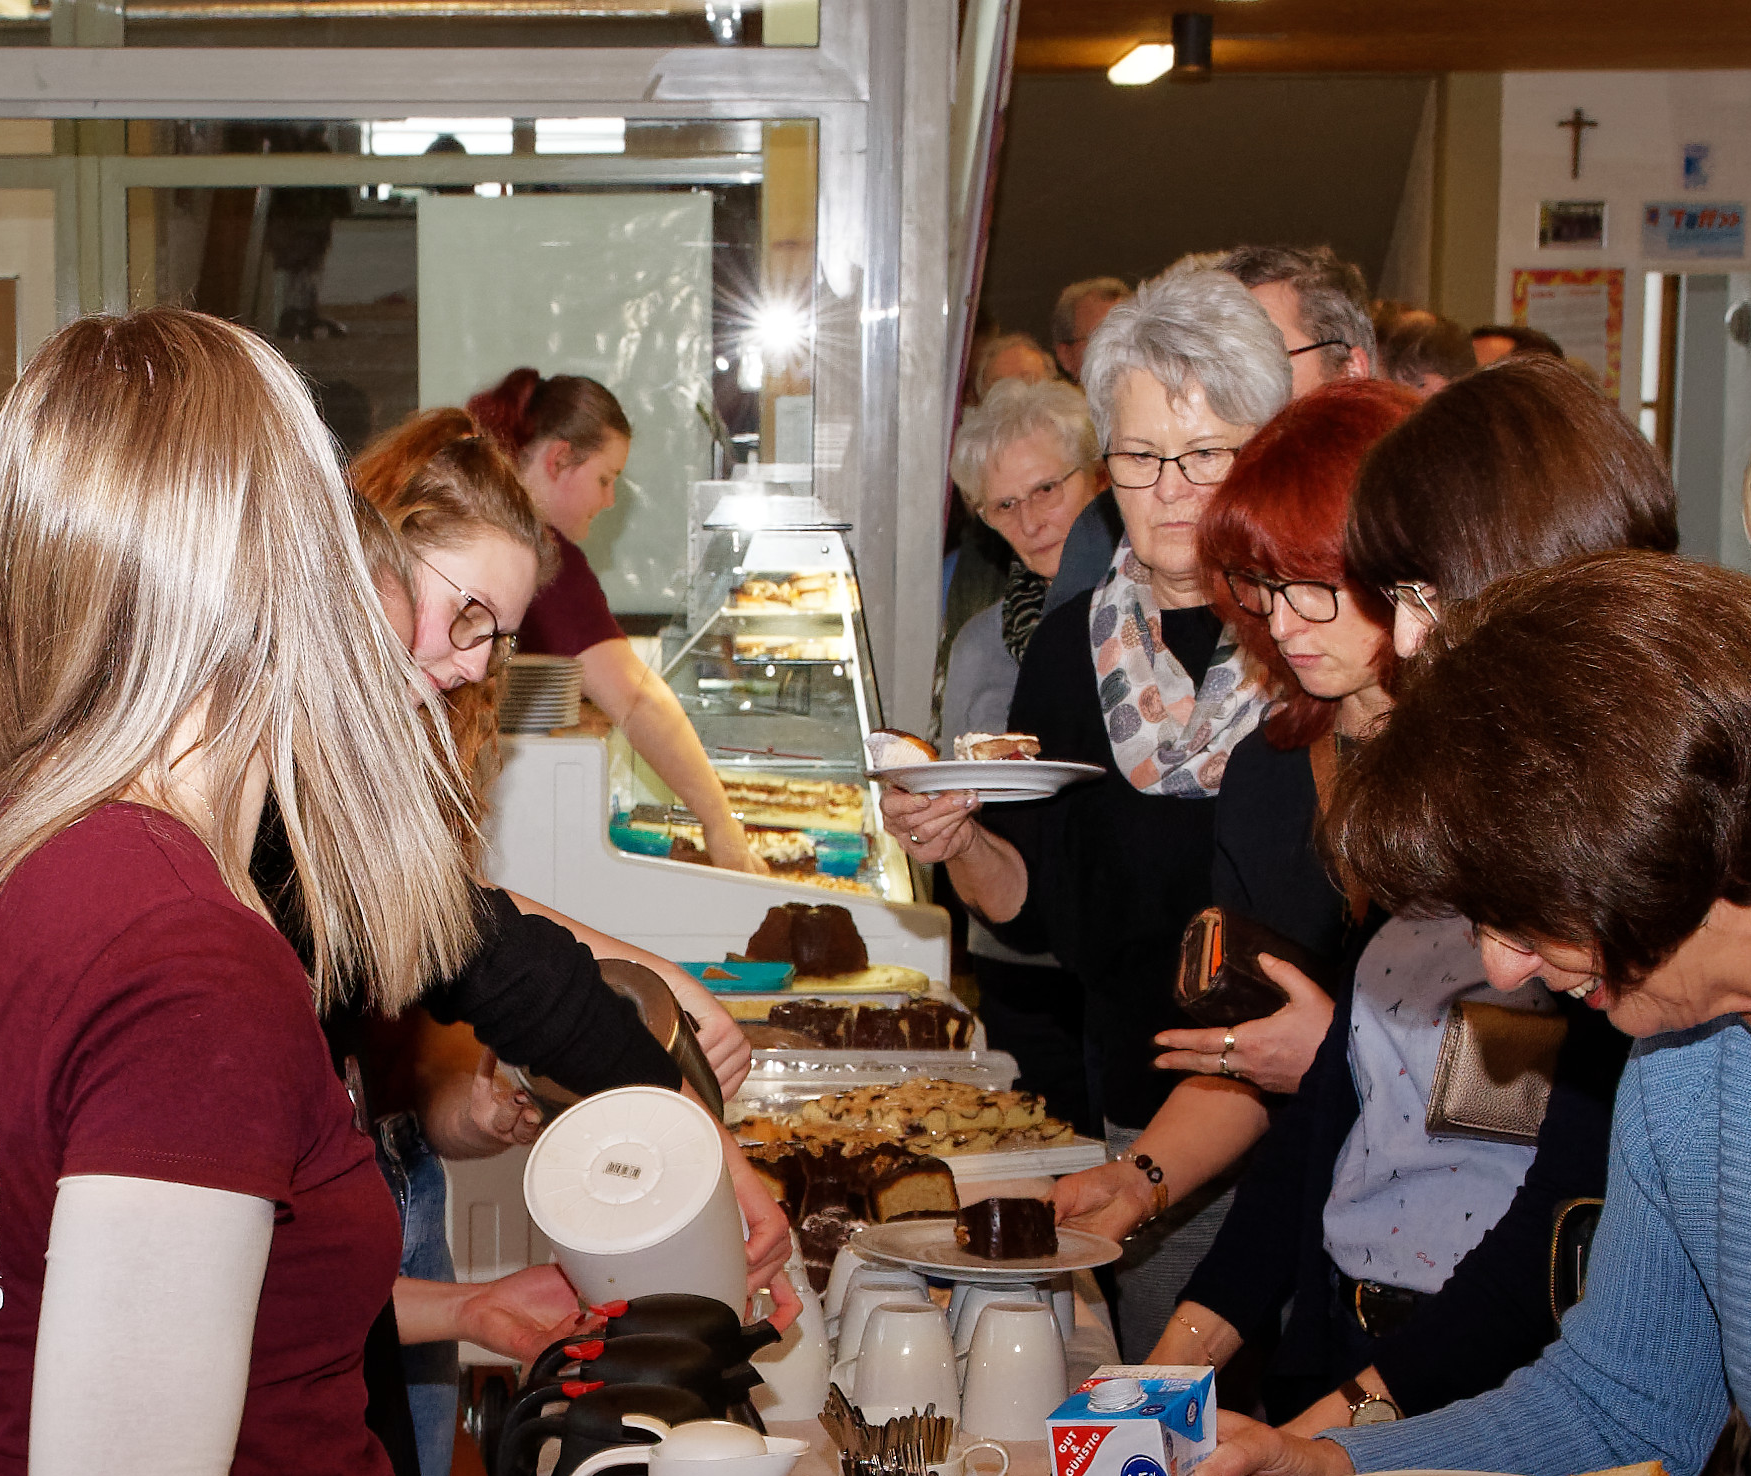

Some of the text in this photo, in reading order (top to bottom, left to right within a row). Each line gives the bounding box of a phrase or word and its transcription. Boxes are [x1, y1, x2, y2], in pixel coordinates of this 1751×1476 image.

[1058, 1430, 1077, 1453] GUT
[1070, 1444, 1081, 1454] &
[1065, 1432, 1101, 1476] GÜNSTIG
